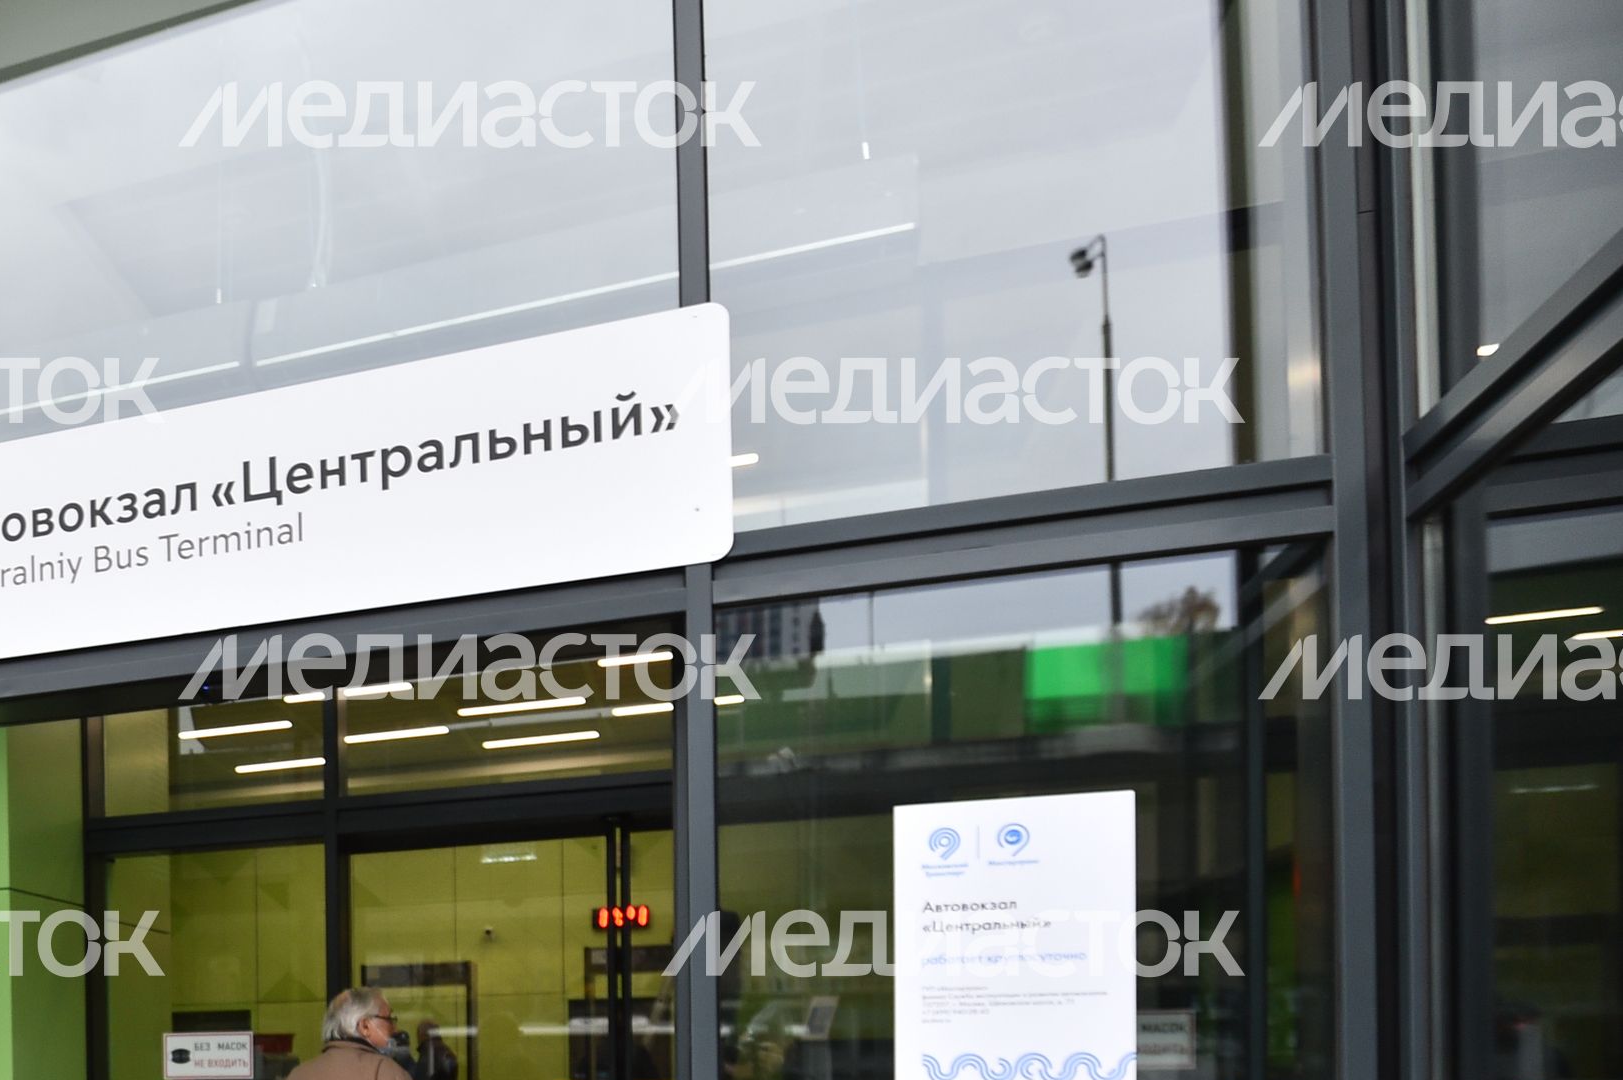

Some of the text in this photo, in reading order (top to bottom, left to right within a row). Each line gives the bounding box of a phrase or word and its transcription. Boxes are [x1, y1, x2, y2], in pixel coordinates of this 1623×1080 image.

[211, 390, 680, 508] «Центральный»
[94, 542, 150, 574] Bus
[159, 512, 306, 561] Terminal
[923, 901, 1017, 913] Автовокзал
[194, 1041, 248, 1052] БЕЗ МАСОК
[194, 1058, 249, 1069] НЕ ВХОДИТЬ
